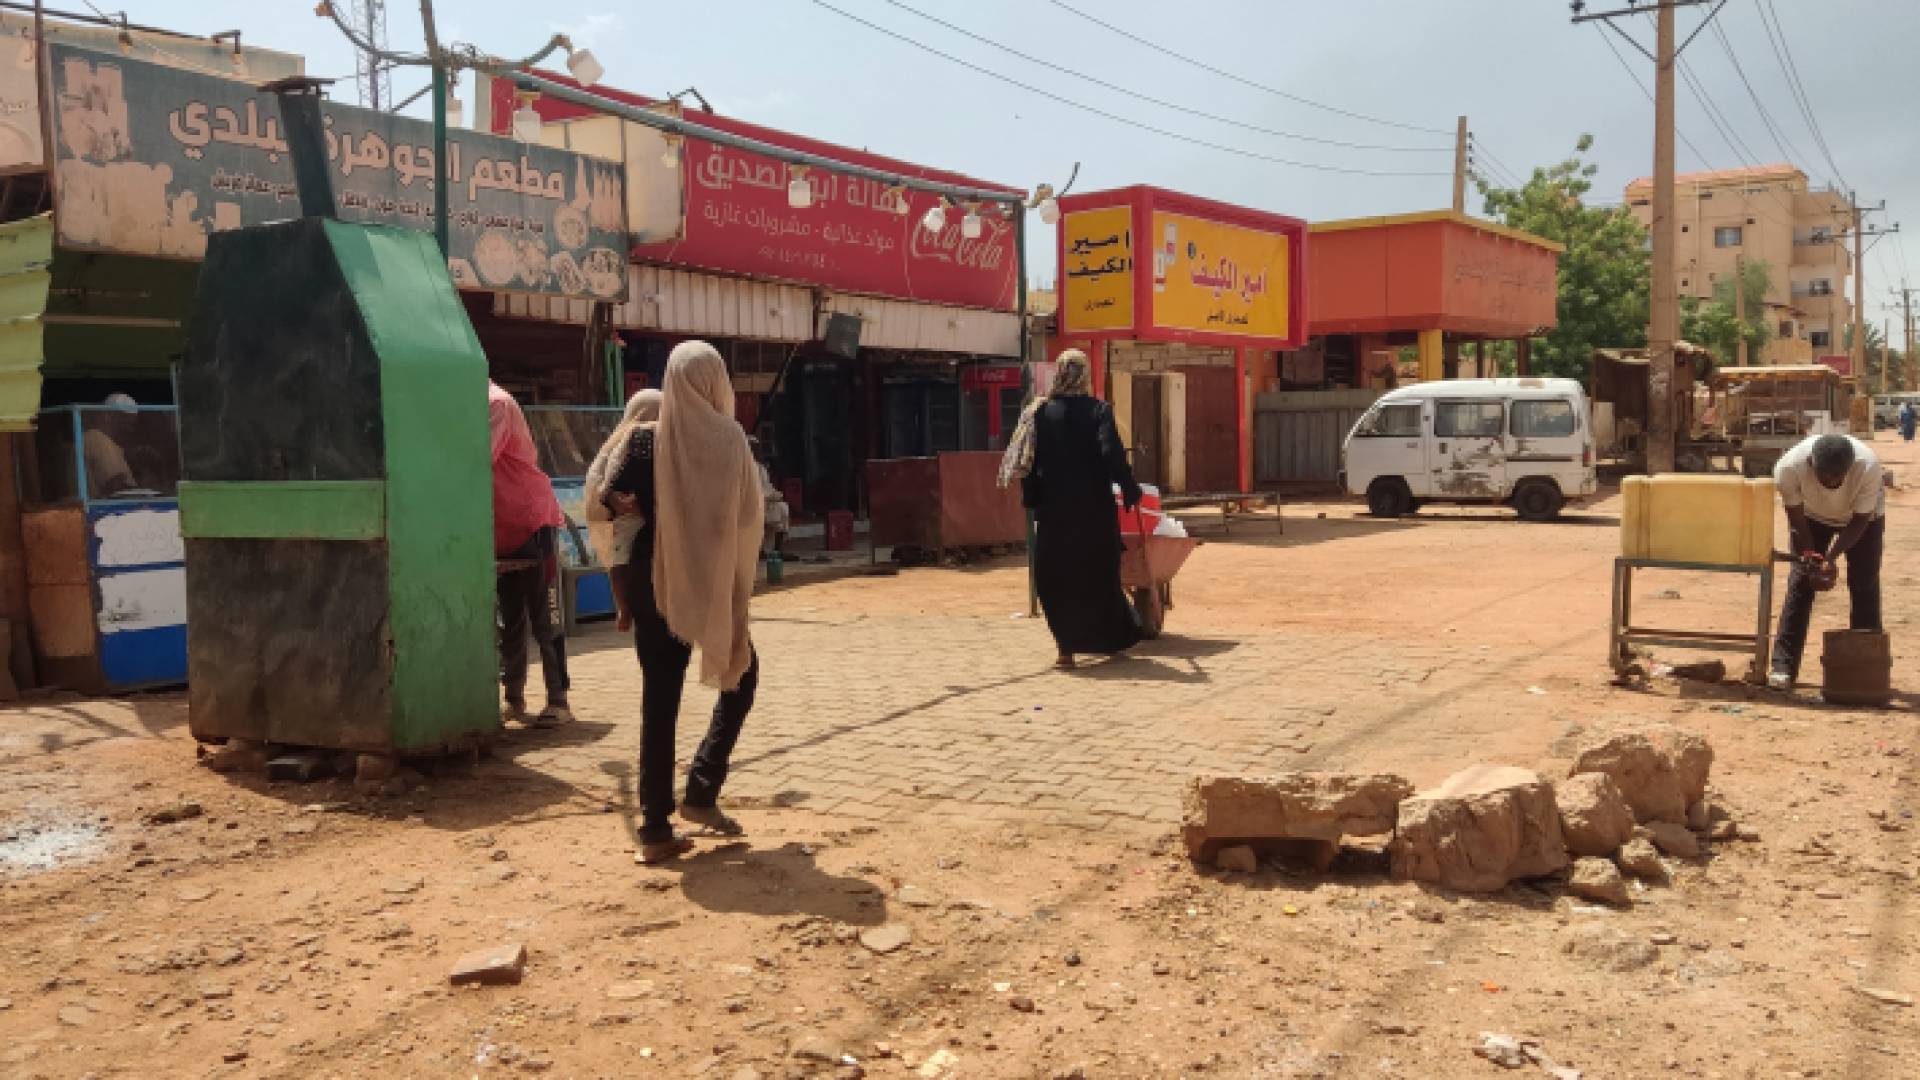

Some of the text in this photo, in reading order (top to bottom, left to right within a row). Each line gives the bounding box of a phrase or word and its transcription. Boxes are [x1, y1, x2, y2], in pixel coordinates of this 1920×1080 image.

[169, 99, 290, 164] بلدي
[469, 155, 566, 202] مطعم
[696, 143, 787, 192] لصديق
